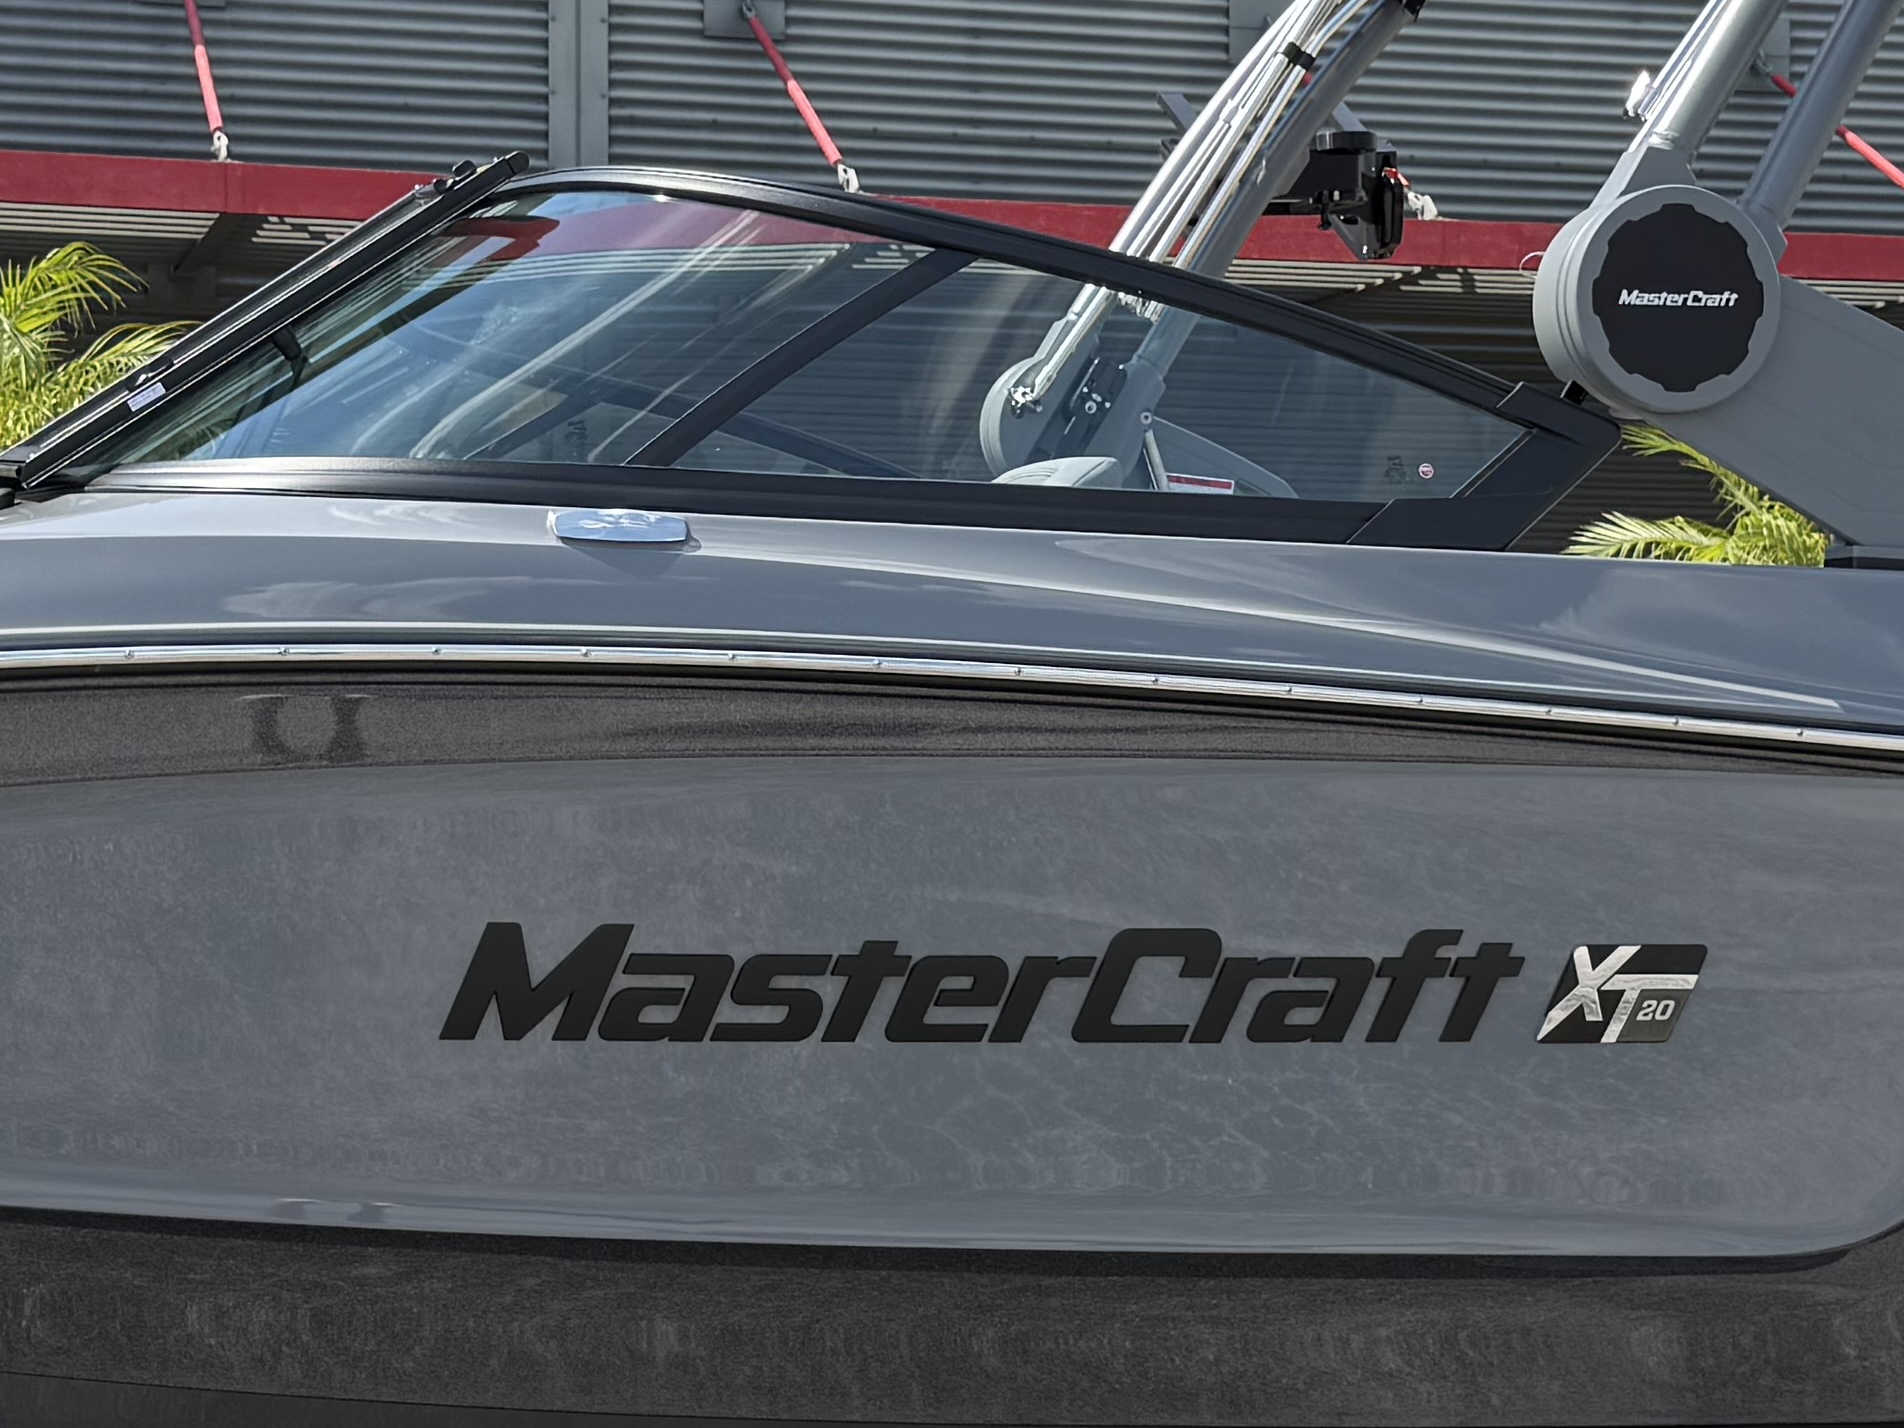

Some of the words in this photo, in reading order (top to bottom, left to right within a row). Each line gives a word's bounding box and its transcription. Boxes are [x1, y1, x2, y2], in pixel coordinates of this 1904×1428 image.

[1617, 288, 1739, 307] MasterCraft
[438, 922, 1526, 1044] MasterCraft
[1536, 944, 1700, 1044] XT
[1636, 999, 1676, 1021] 20
